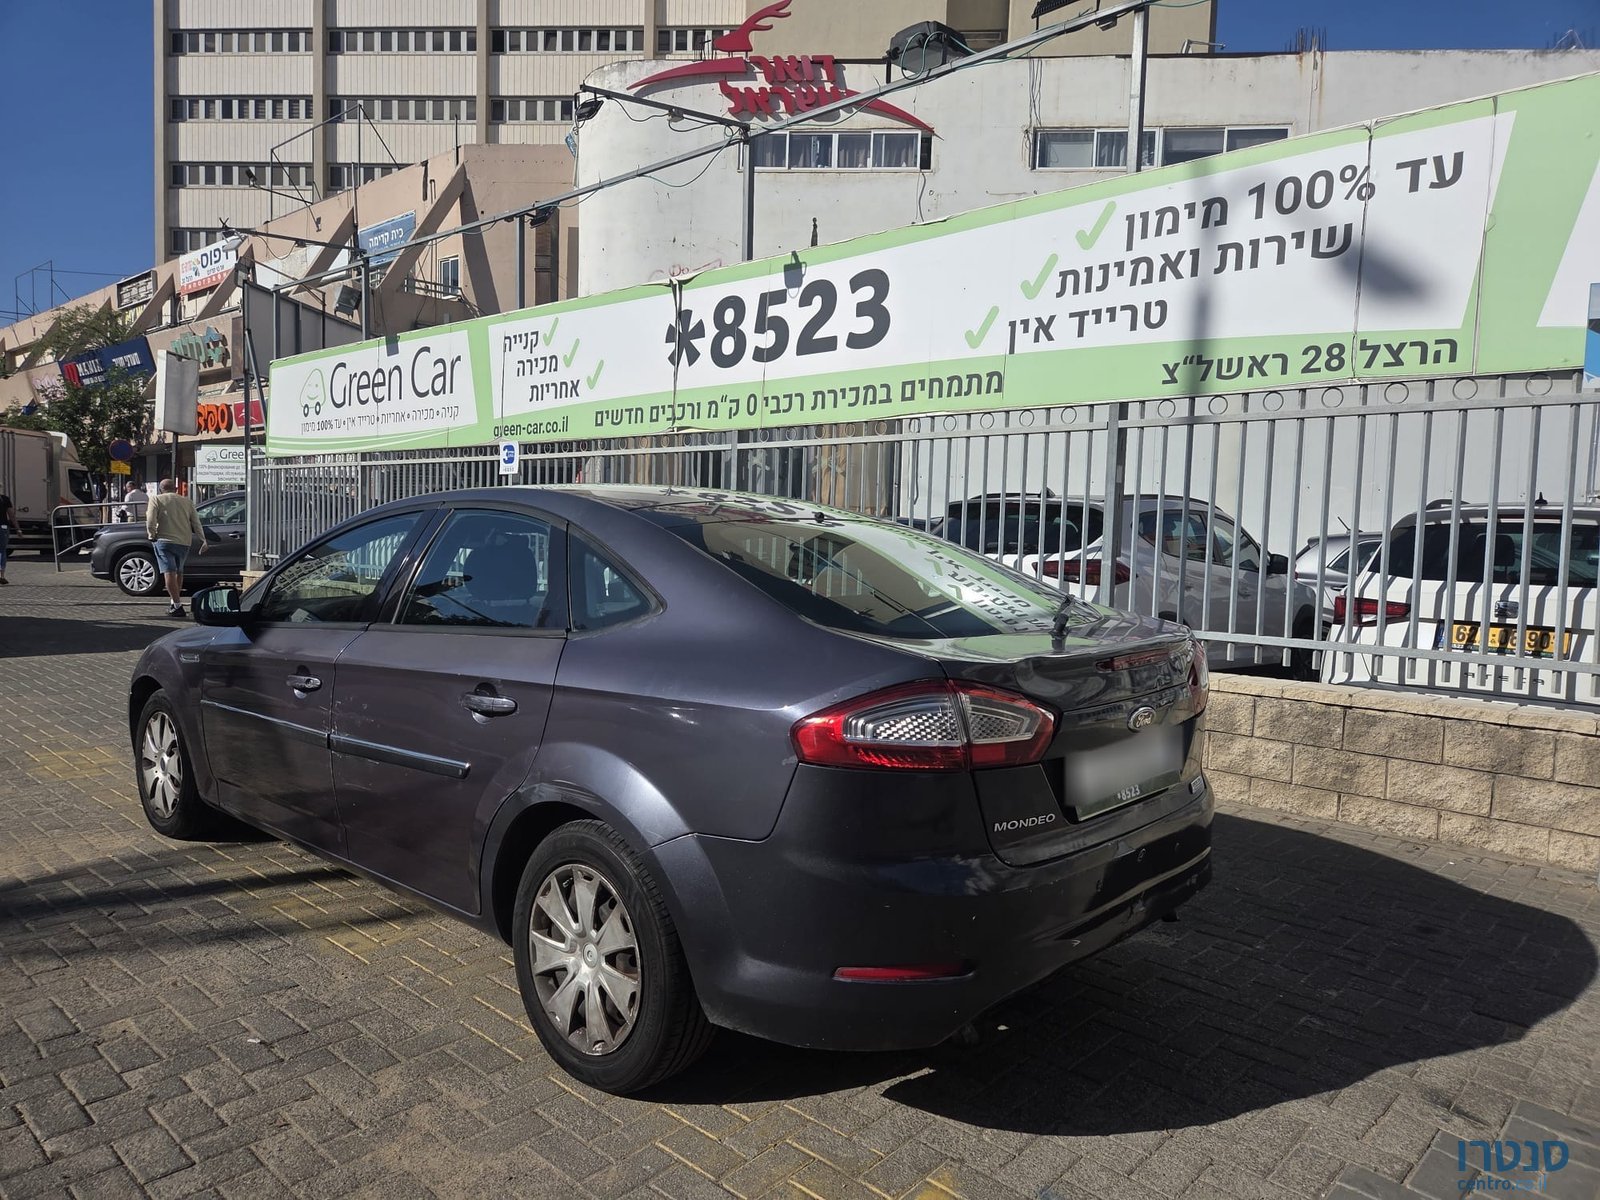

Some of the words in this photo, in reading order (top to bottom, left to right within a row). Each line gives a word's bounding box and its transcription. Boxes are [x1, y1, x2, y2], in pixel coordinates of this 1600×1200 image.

[749, 55, 836, 84] דואר
[1396, 150, 1465, 194] עד
[1248, 163, 1376, 220] 100%
[1124, 197, 1229, 252] מימון
[1213, 222, 1353, 276] שירות
[1056, 246, 1200, 299] ואמינות
[1067, 299, 1169, 333] טרייד
[503, 329, 540, 354] קנייה
[1007, 312, 1055, 355] אין
[516, 354, 559, 378] מכירה
[1301, 339, 1346, 374] 28
[1358, 336, 1458, 371] הרצל
[330, 358, 402, 410] Green
[411, 346, 461, 399] Car
[529, 379, 580, 403] אחריות
[900, 370, 1002, 403] מתמחים
[764, 393, 804, 416] רכבי
[812, 381, 892, 411] במכירת
[317, 420, 333, 431] 100%
[358, 414, 375, 426] טרייד
[381, 411, 406, 424] אחריות
[412, 408, 434, 422] מכירה
[441, 405, 459, 421] קניה
[594, 405, 644, 428] חדשים
[649, 402, 701, 424] ורכבים
[220, 448, 244, 460] Gree
[994, 813, 1056, 832] MONDEO
